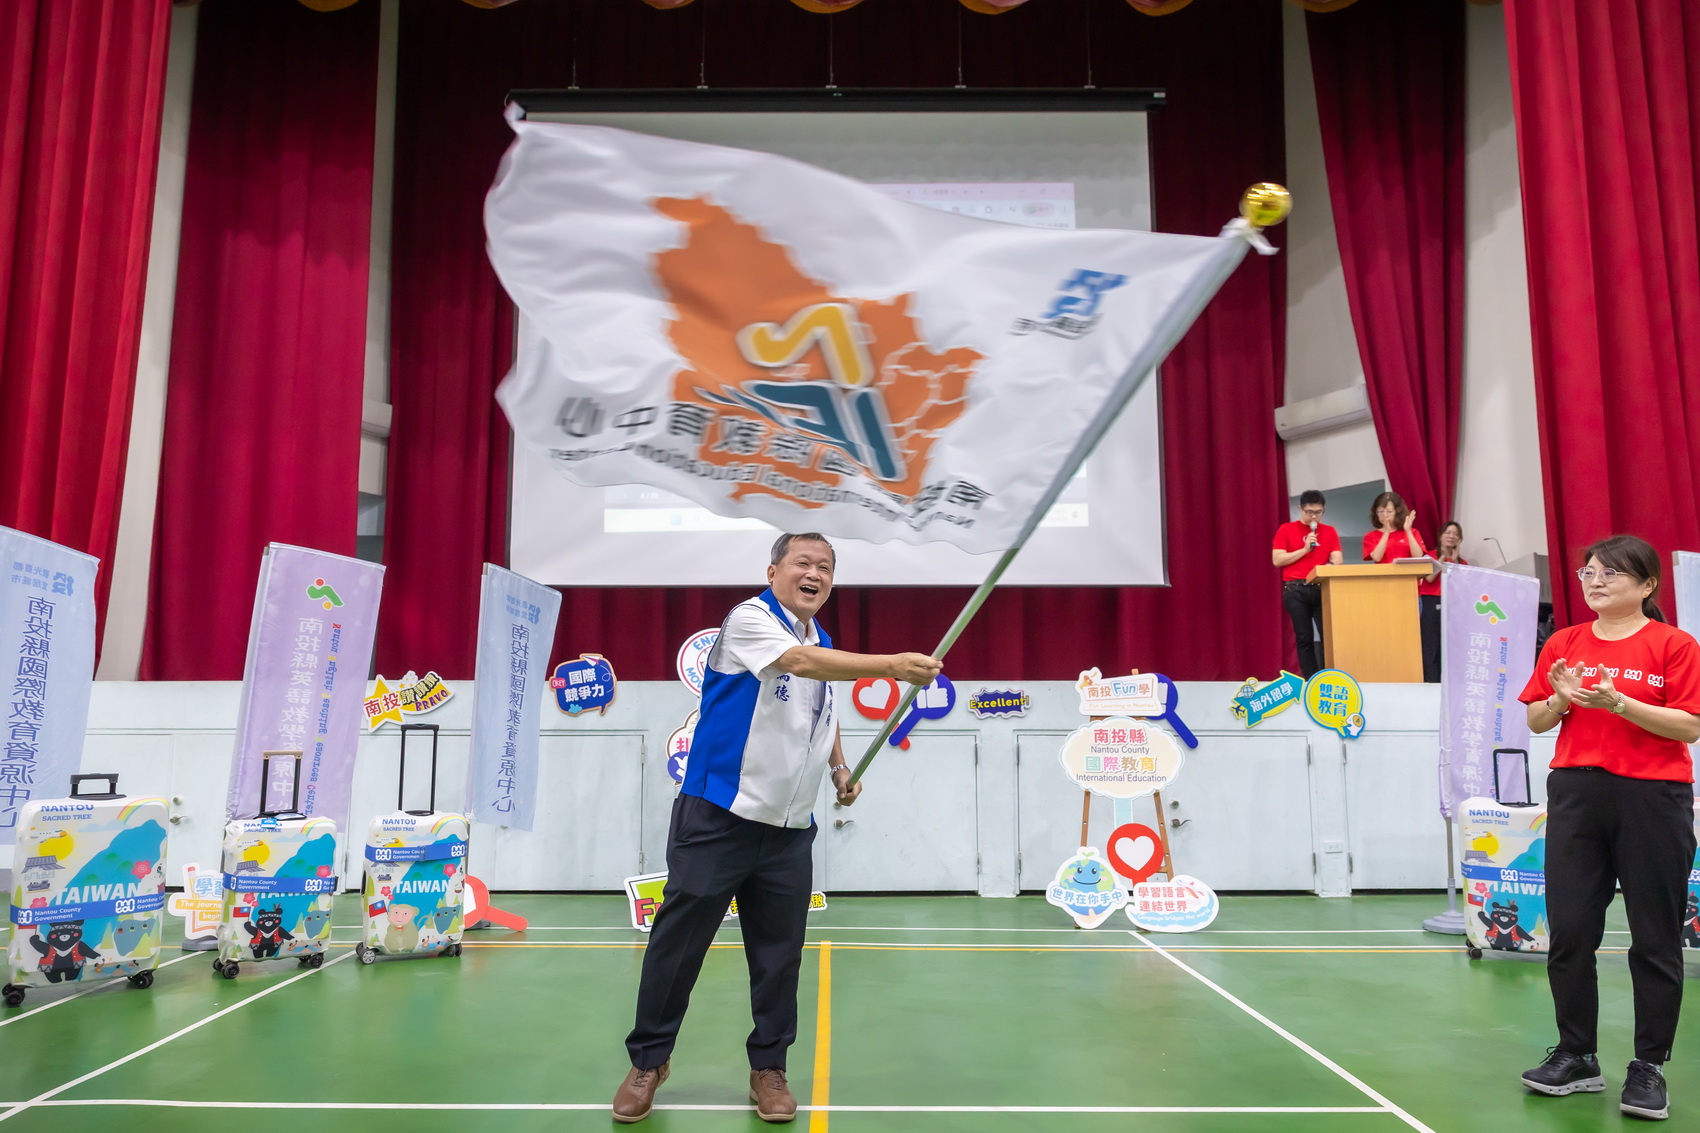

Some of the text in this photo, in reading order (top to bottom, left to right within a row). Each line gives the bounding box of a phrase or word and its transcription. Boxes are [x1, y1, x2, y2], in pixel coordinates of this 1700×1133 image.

[568, 668, 597, 685] 國際
[564, 684, 605, 703] 競爭力
[1250, 682, 1294, 712] 海外留學
[1319, 683, 1349, 700] 雙語
[415, 689, 448, 711] BRAVO
[970, 695, 1029, 709] Excellent!
[1318, 699, 1347, 717] 教育
[1094, 729, 1146, 743] 南投縣
[1121, 746, 1150, 754] County
[1086, 756, 1154, 771] 國際教育
[1076, 774, 1167, 782] International Education
[41, 804, 94, 812] NANTOU
[1469, 809, 1510, 818] NANTOU
[54, 882, 141, 905] TAIWAN
[395, 880, 450, 893] TAIWAN
[1138, 887, 1185, 898] 學習語言
[137, 896, 158, 904] Nantou
[1052, 888, 1123, 905] 世界在你手中
[1139, 901, 1187, 912] 連結世界
[34, 913, 73, 922] Government
